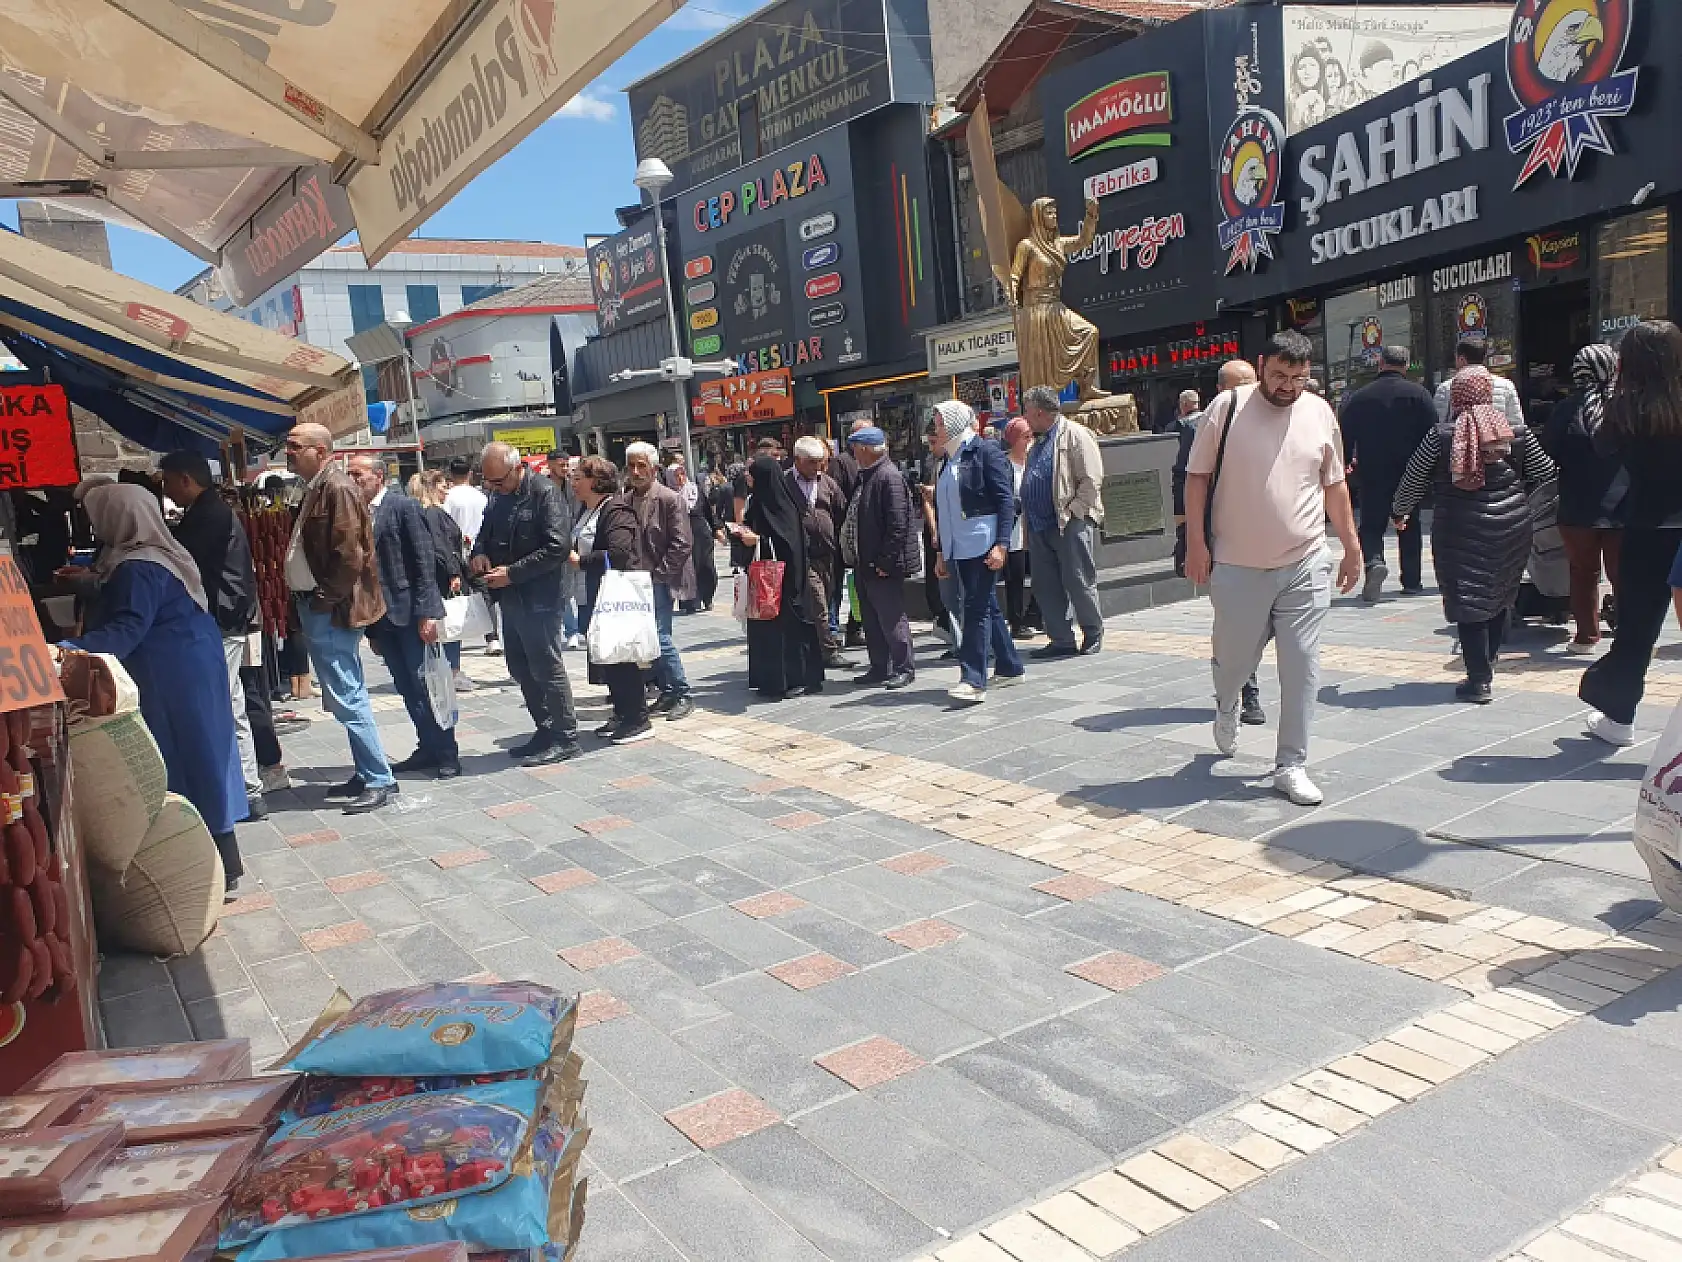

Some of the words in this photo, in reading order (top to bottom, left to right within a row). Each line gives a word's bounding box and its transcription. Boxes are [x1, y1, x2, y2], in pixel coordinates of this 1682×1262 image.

[714, 10, 824, 97] PLAZA
[759, 46, 849, 112] MENKUL
[1589, 84, 1623, 106] beri
[1070, 91, 1168, 143] İMAMOĞLU
[1299, 72, 1492, 227] ŞAHİN
[693, 190, 735, 233] CEP
[740, 153, 827, 216] PLAZA
[1090, 166, 1151, 197] fabrika
[1311, 185, 1480, 266] SUCUKLARI
[1379, 274, 1416, 308] ŞAHİN
[1432, 252, 1513, 293] SUCUKLARI
[735, 336, 823, 376] KSESUAR
[938, 340, 966, 356] HALK
